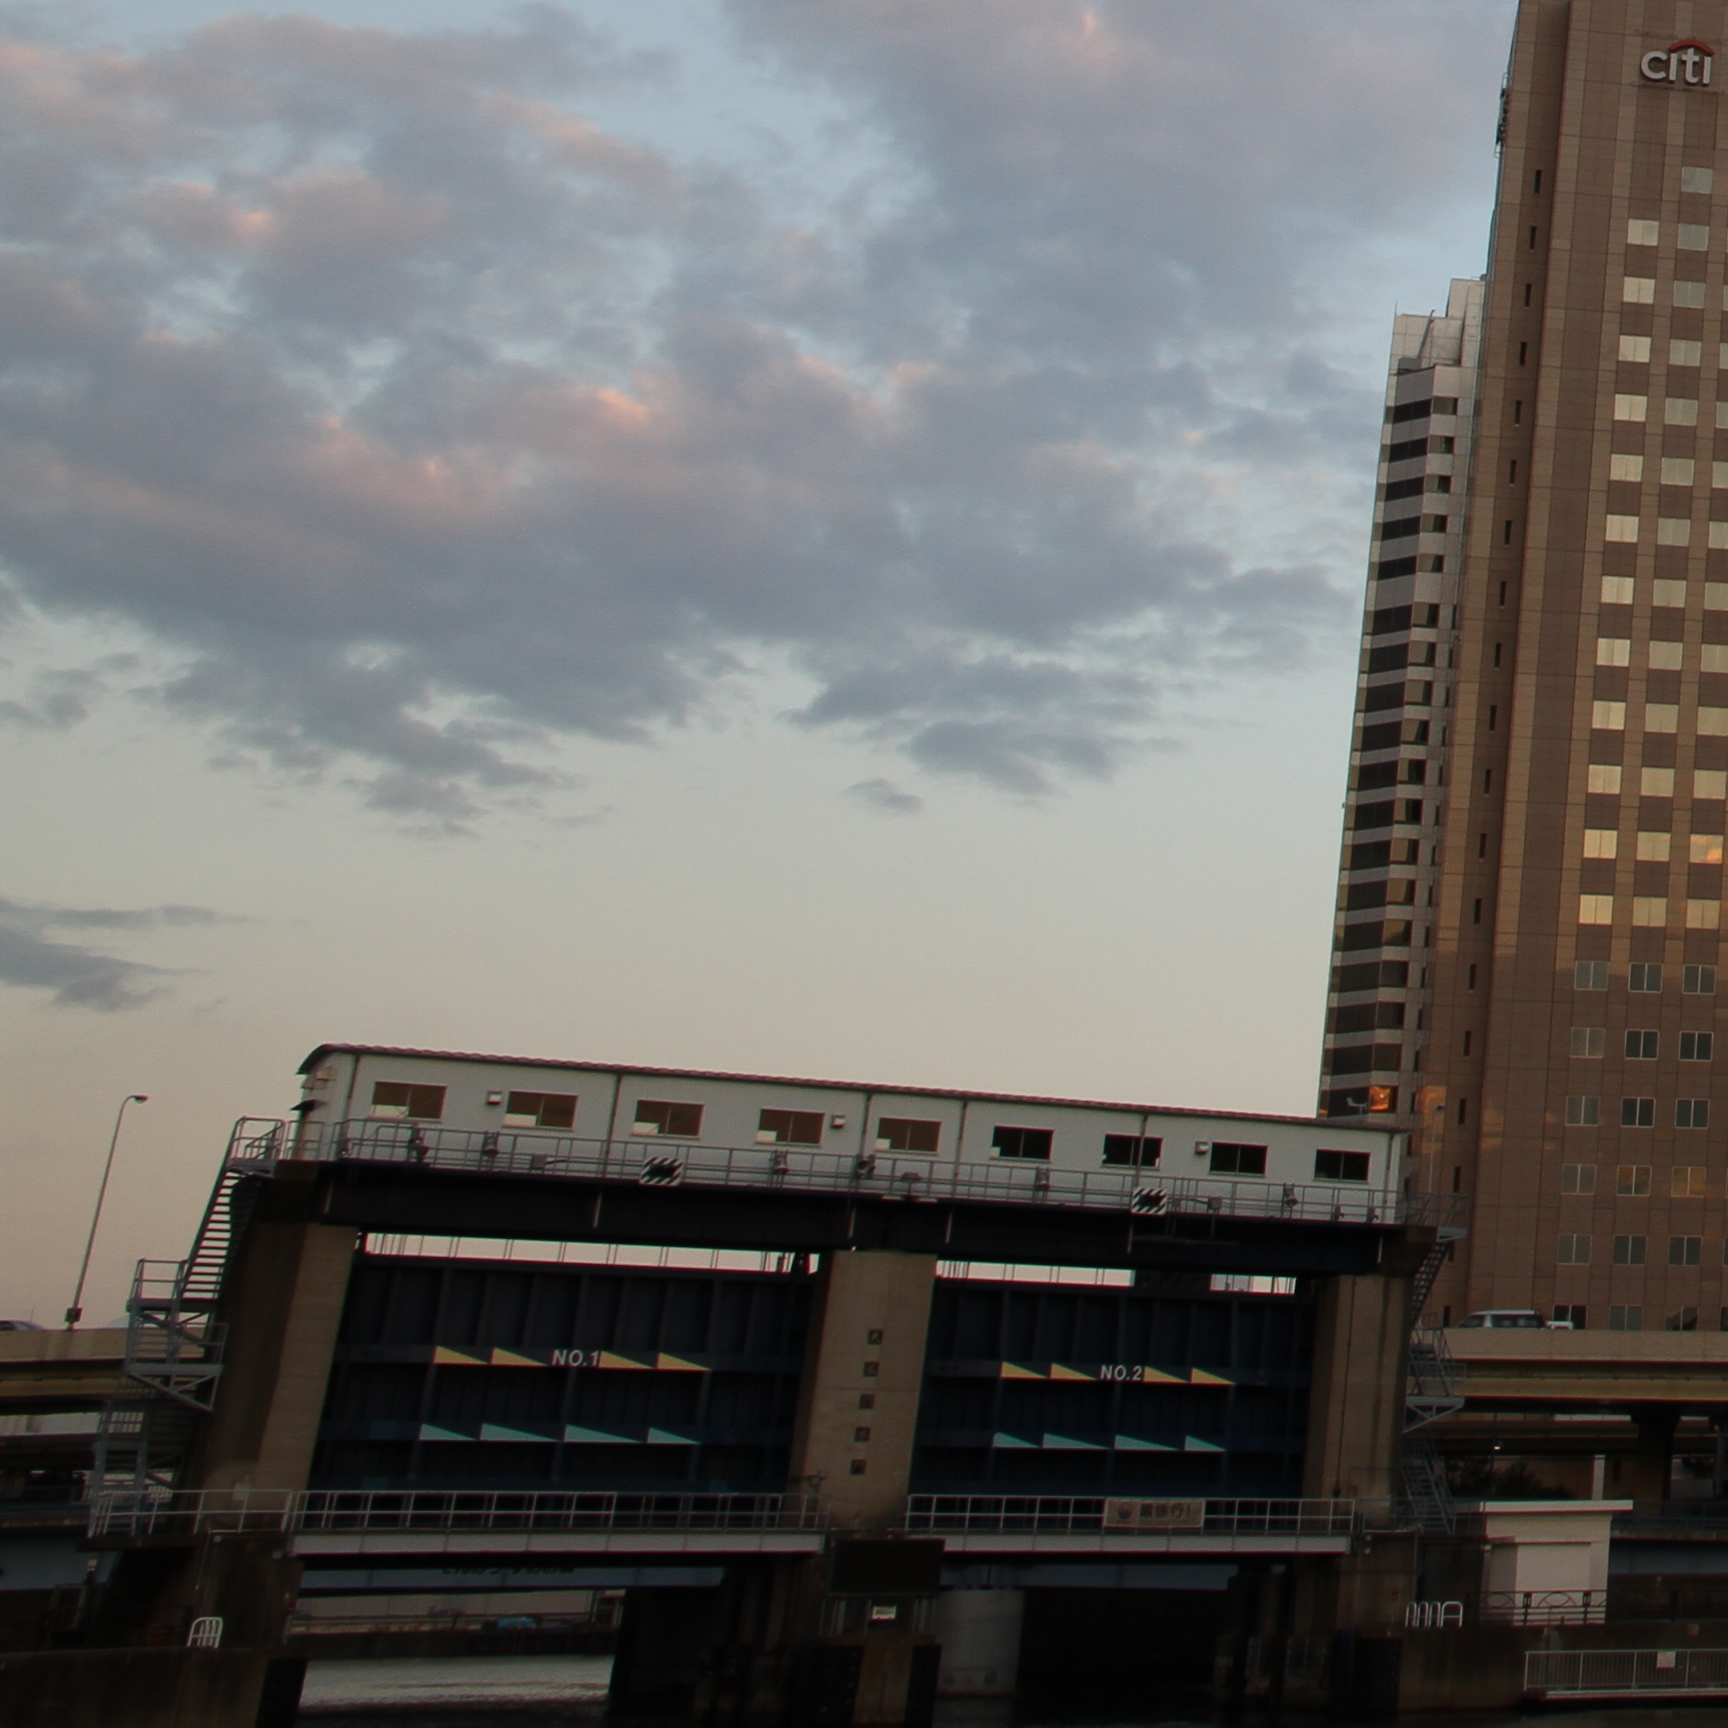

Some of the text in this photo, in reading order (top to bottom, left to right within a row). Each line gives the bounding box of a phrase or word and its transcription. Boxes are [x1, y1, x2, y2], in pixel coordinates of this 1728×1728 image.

[1640, 45, 1712, 85] citi
[552, 1348, 600, 1367] NO.1
[1100, 1364, 1143, 1381] NO.2
